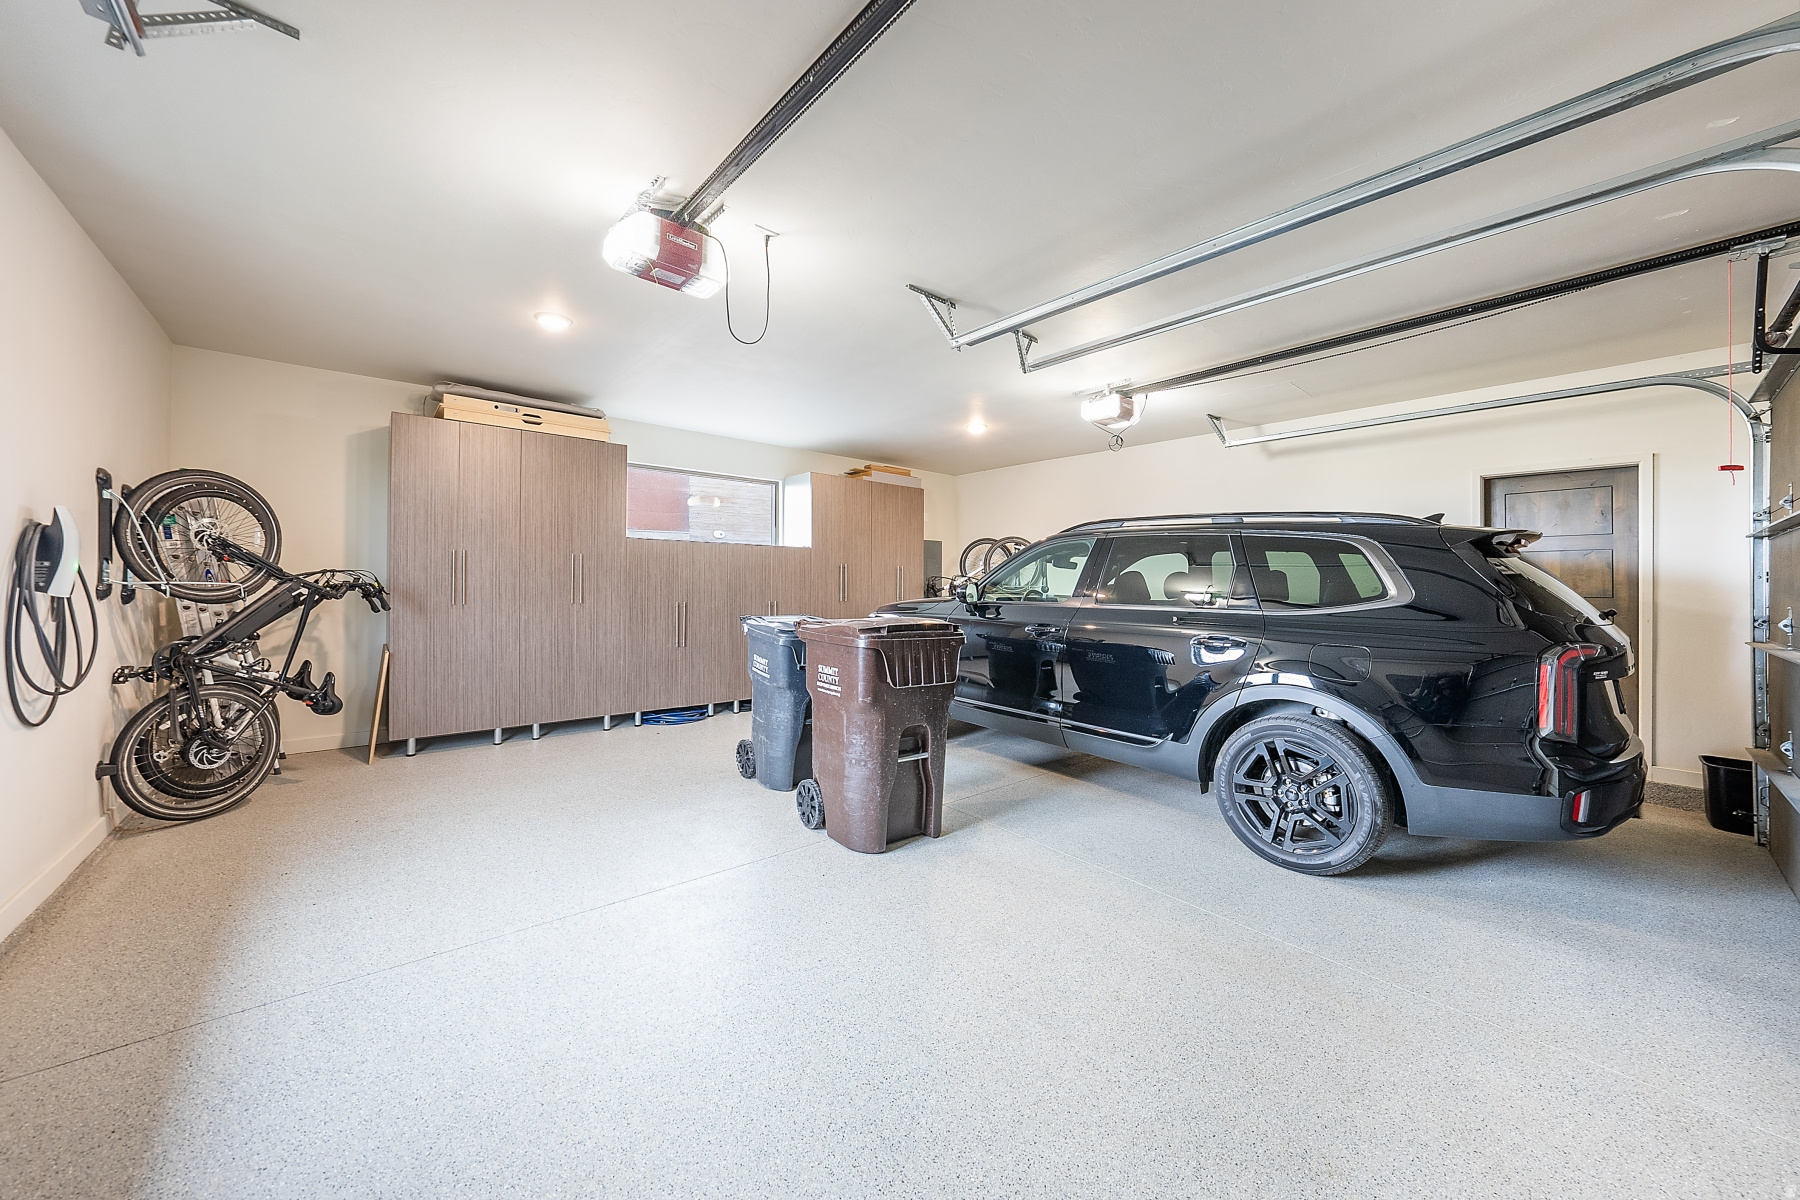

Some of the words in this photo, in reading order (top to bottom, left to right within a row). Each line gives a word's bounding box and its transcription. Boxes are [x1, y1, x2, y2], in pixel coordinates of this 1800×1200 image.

[817, 664, 839, 676] SUMMIT
[817, 673, 839, 685] COUNTY
[1219, 754, 1231, 800] MICHELIN
[1355, 792, 1371, 845] MICHELIN
